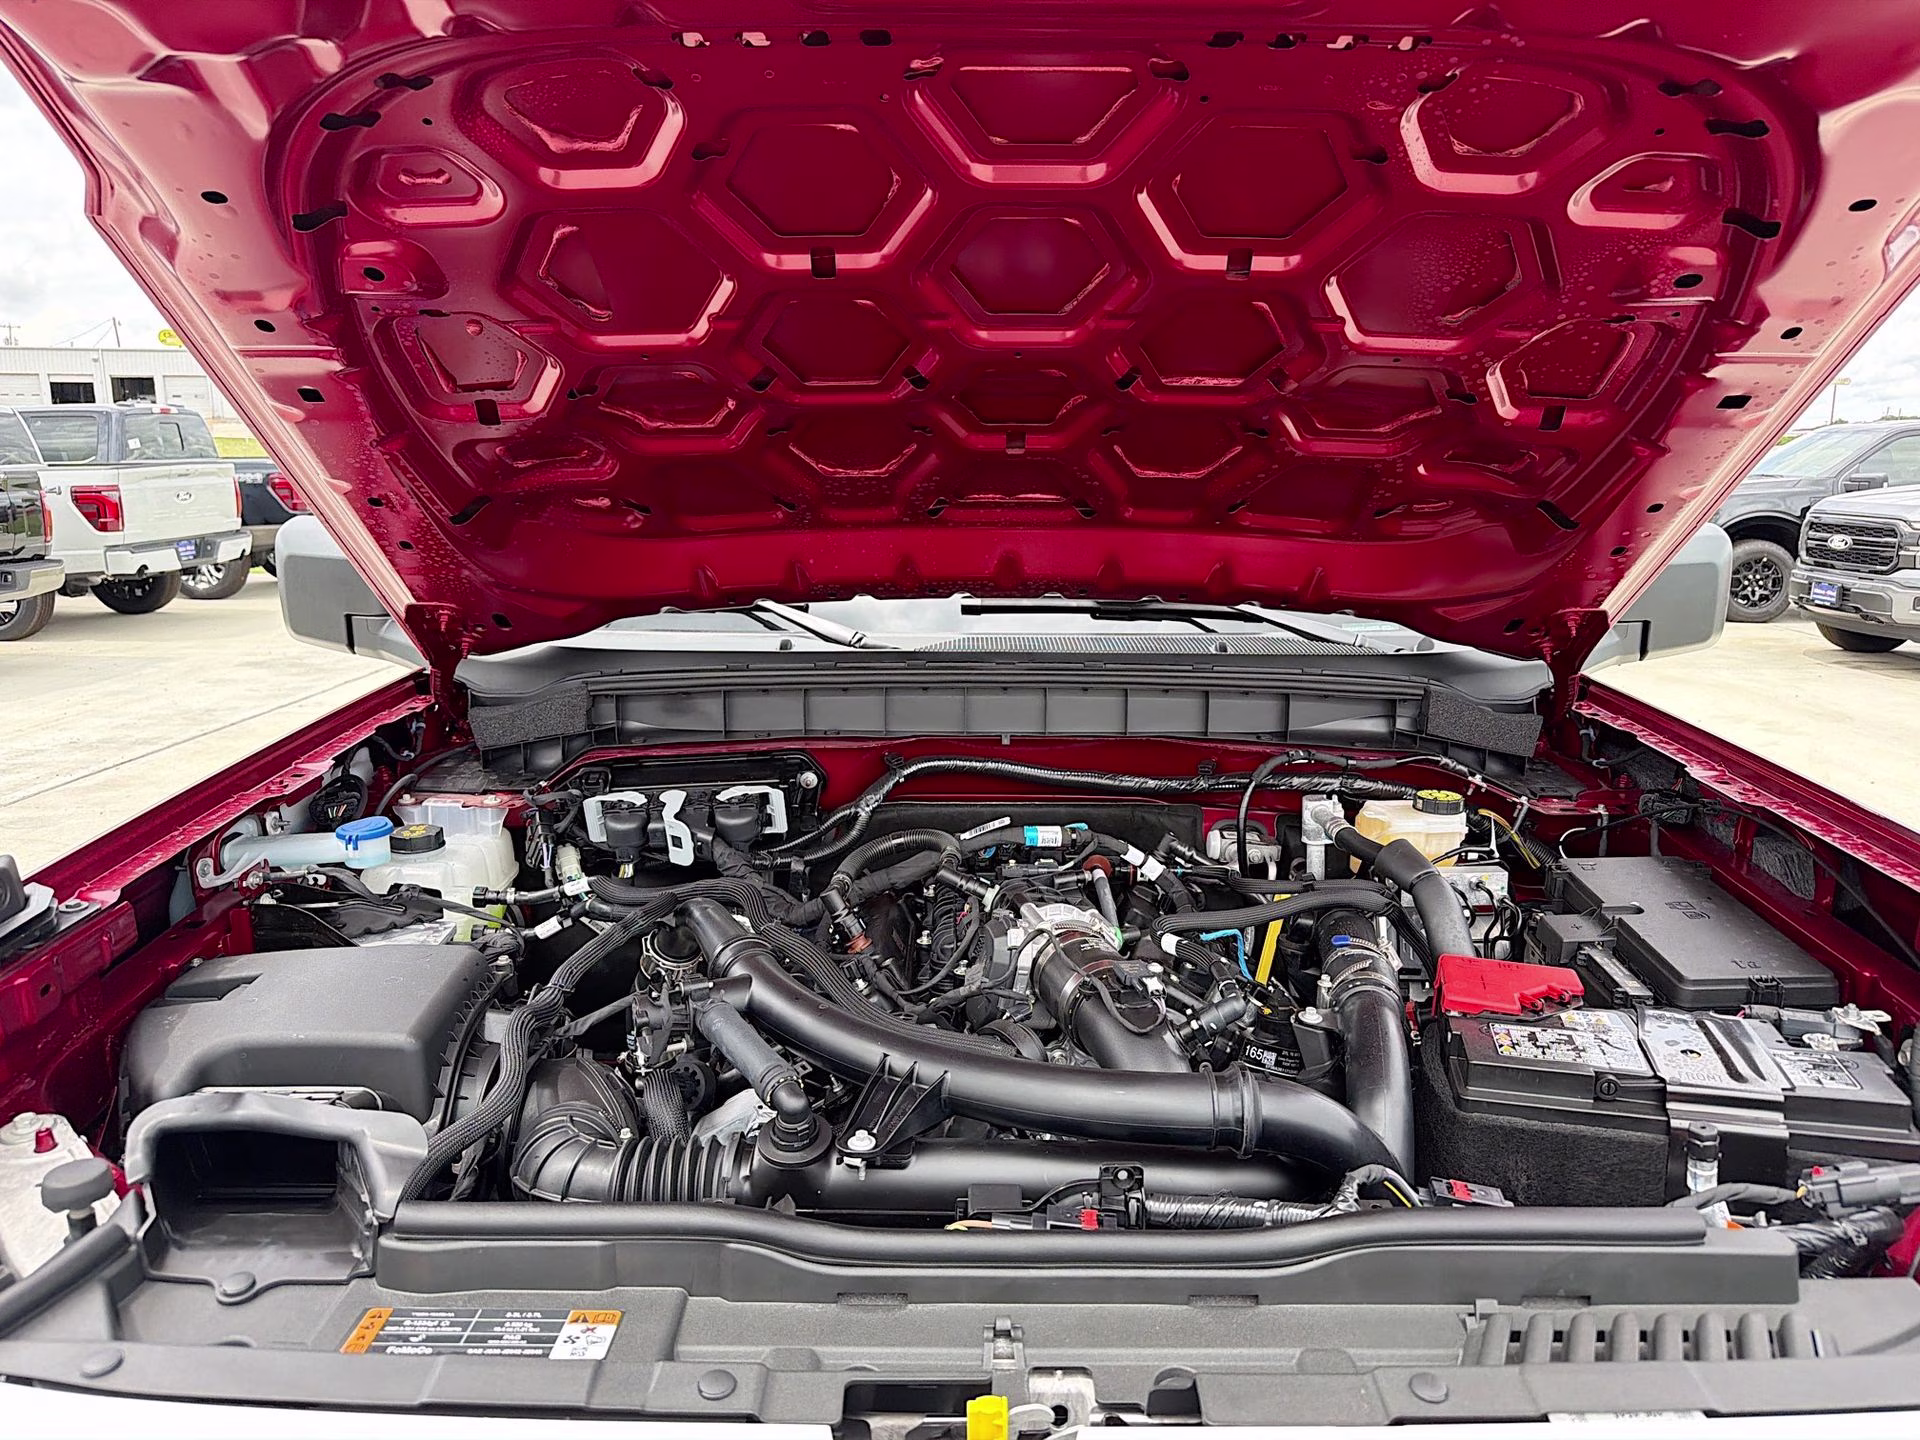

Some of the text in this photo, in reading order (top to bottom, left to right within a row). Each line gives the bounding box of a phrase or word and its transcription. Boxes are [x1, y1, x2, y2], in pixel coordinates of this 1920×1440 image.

[1245, 1044, 1264, 1061] 165
[1677, 1070, 1723, 1083] FRONT
[385, 1345, 433, 1355] FoMoCo
